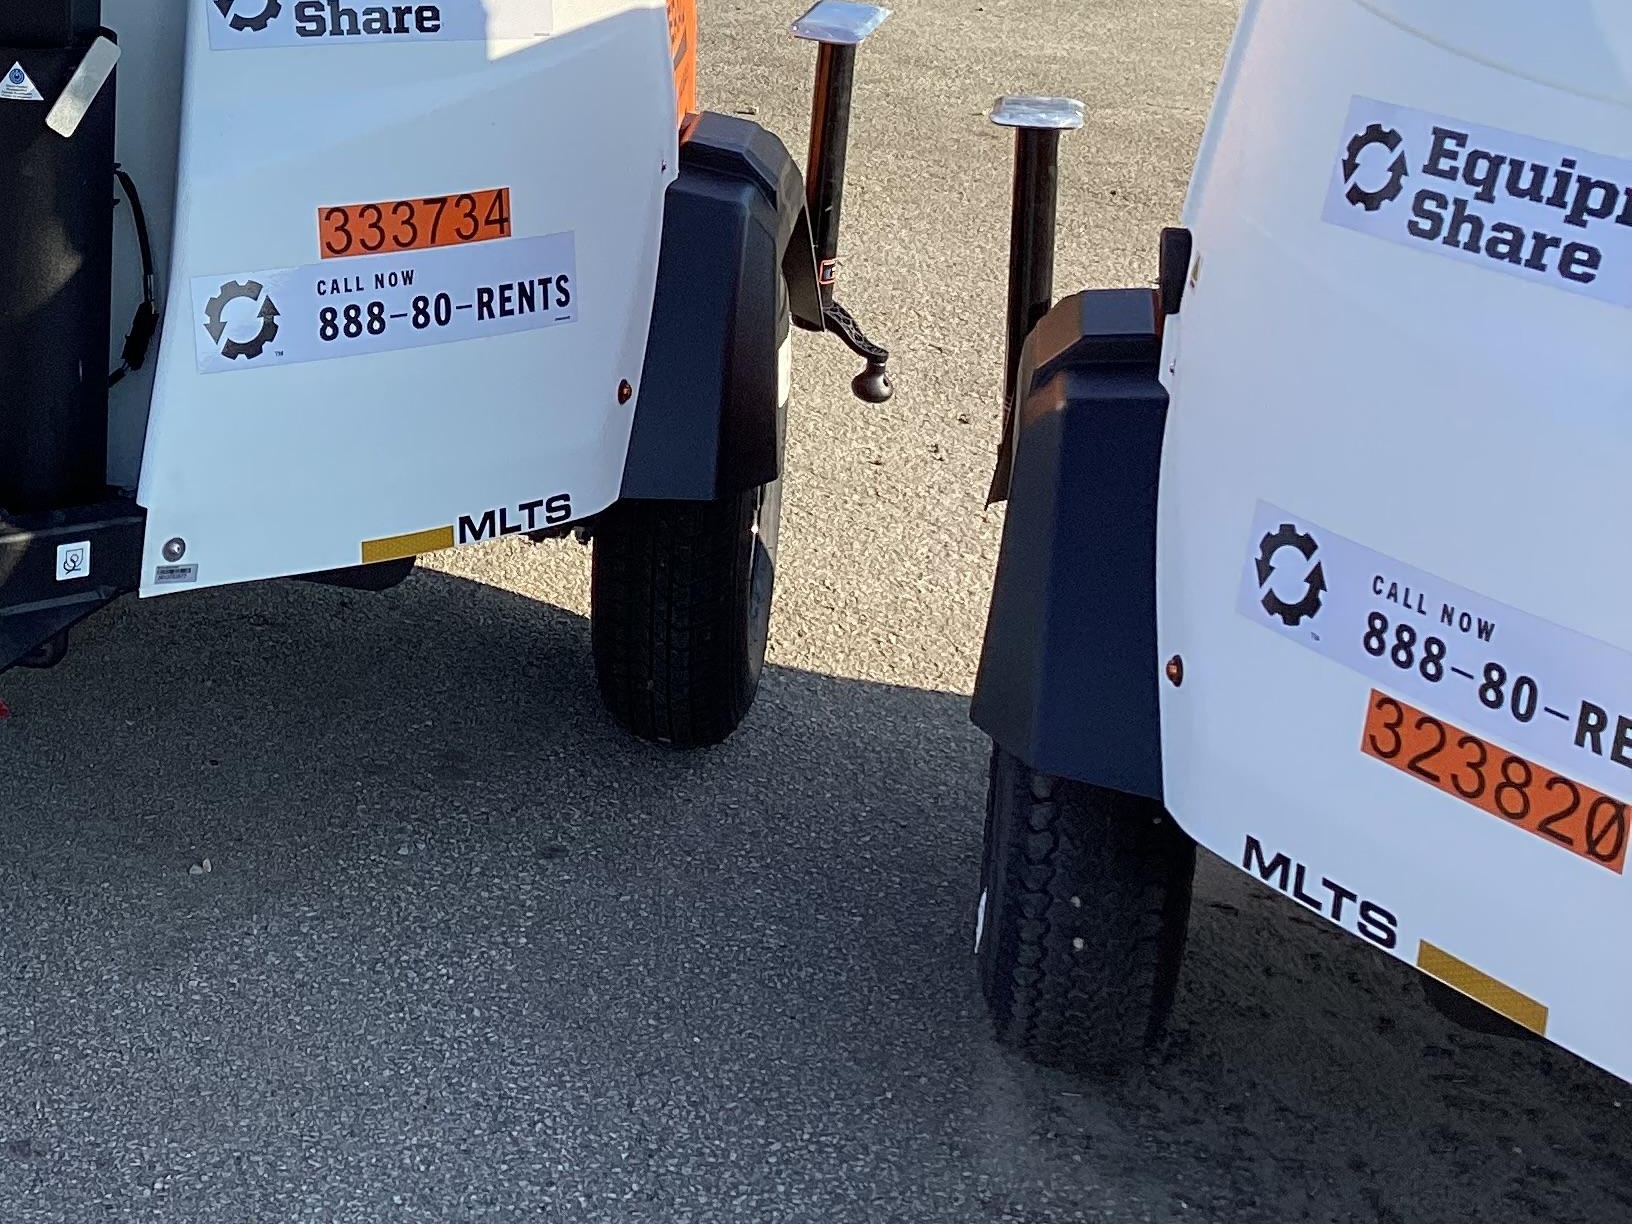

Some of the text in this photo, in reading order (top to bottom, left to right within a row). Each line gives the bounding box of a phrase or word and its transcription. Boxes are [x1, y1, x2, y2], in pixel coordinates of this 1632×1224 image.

[1422, 126, 1632, 227] Equip
[323, 190, 510, 257] 333734
[1406, 188, 1603, 285] Share
[316, 269, 415, 296] CALL NOW
[319, 273, 571, 342] 888-80-RENTS
[458, 493, 573, 544] MLTS
[1371, 575, 1497, 643] CALL NOW
[1368, 697, 1628, 860] 323820
[1242, 834, 1398, 950] MLTS
